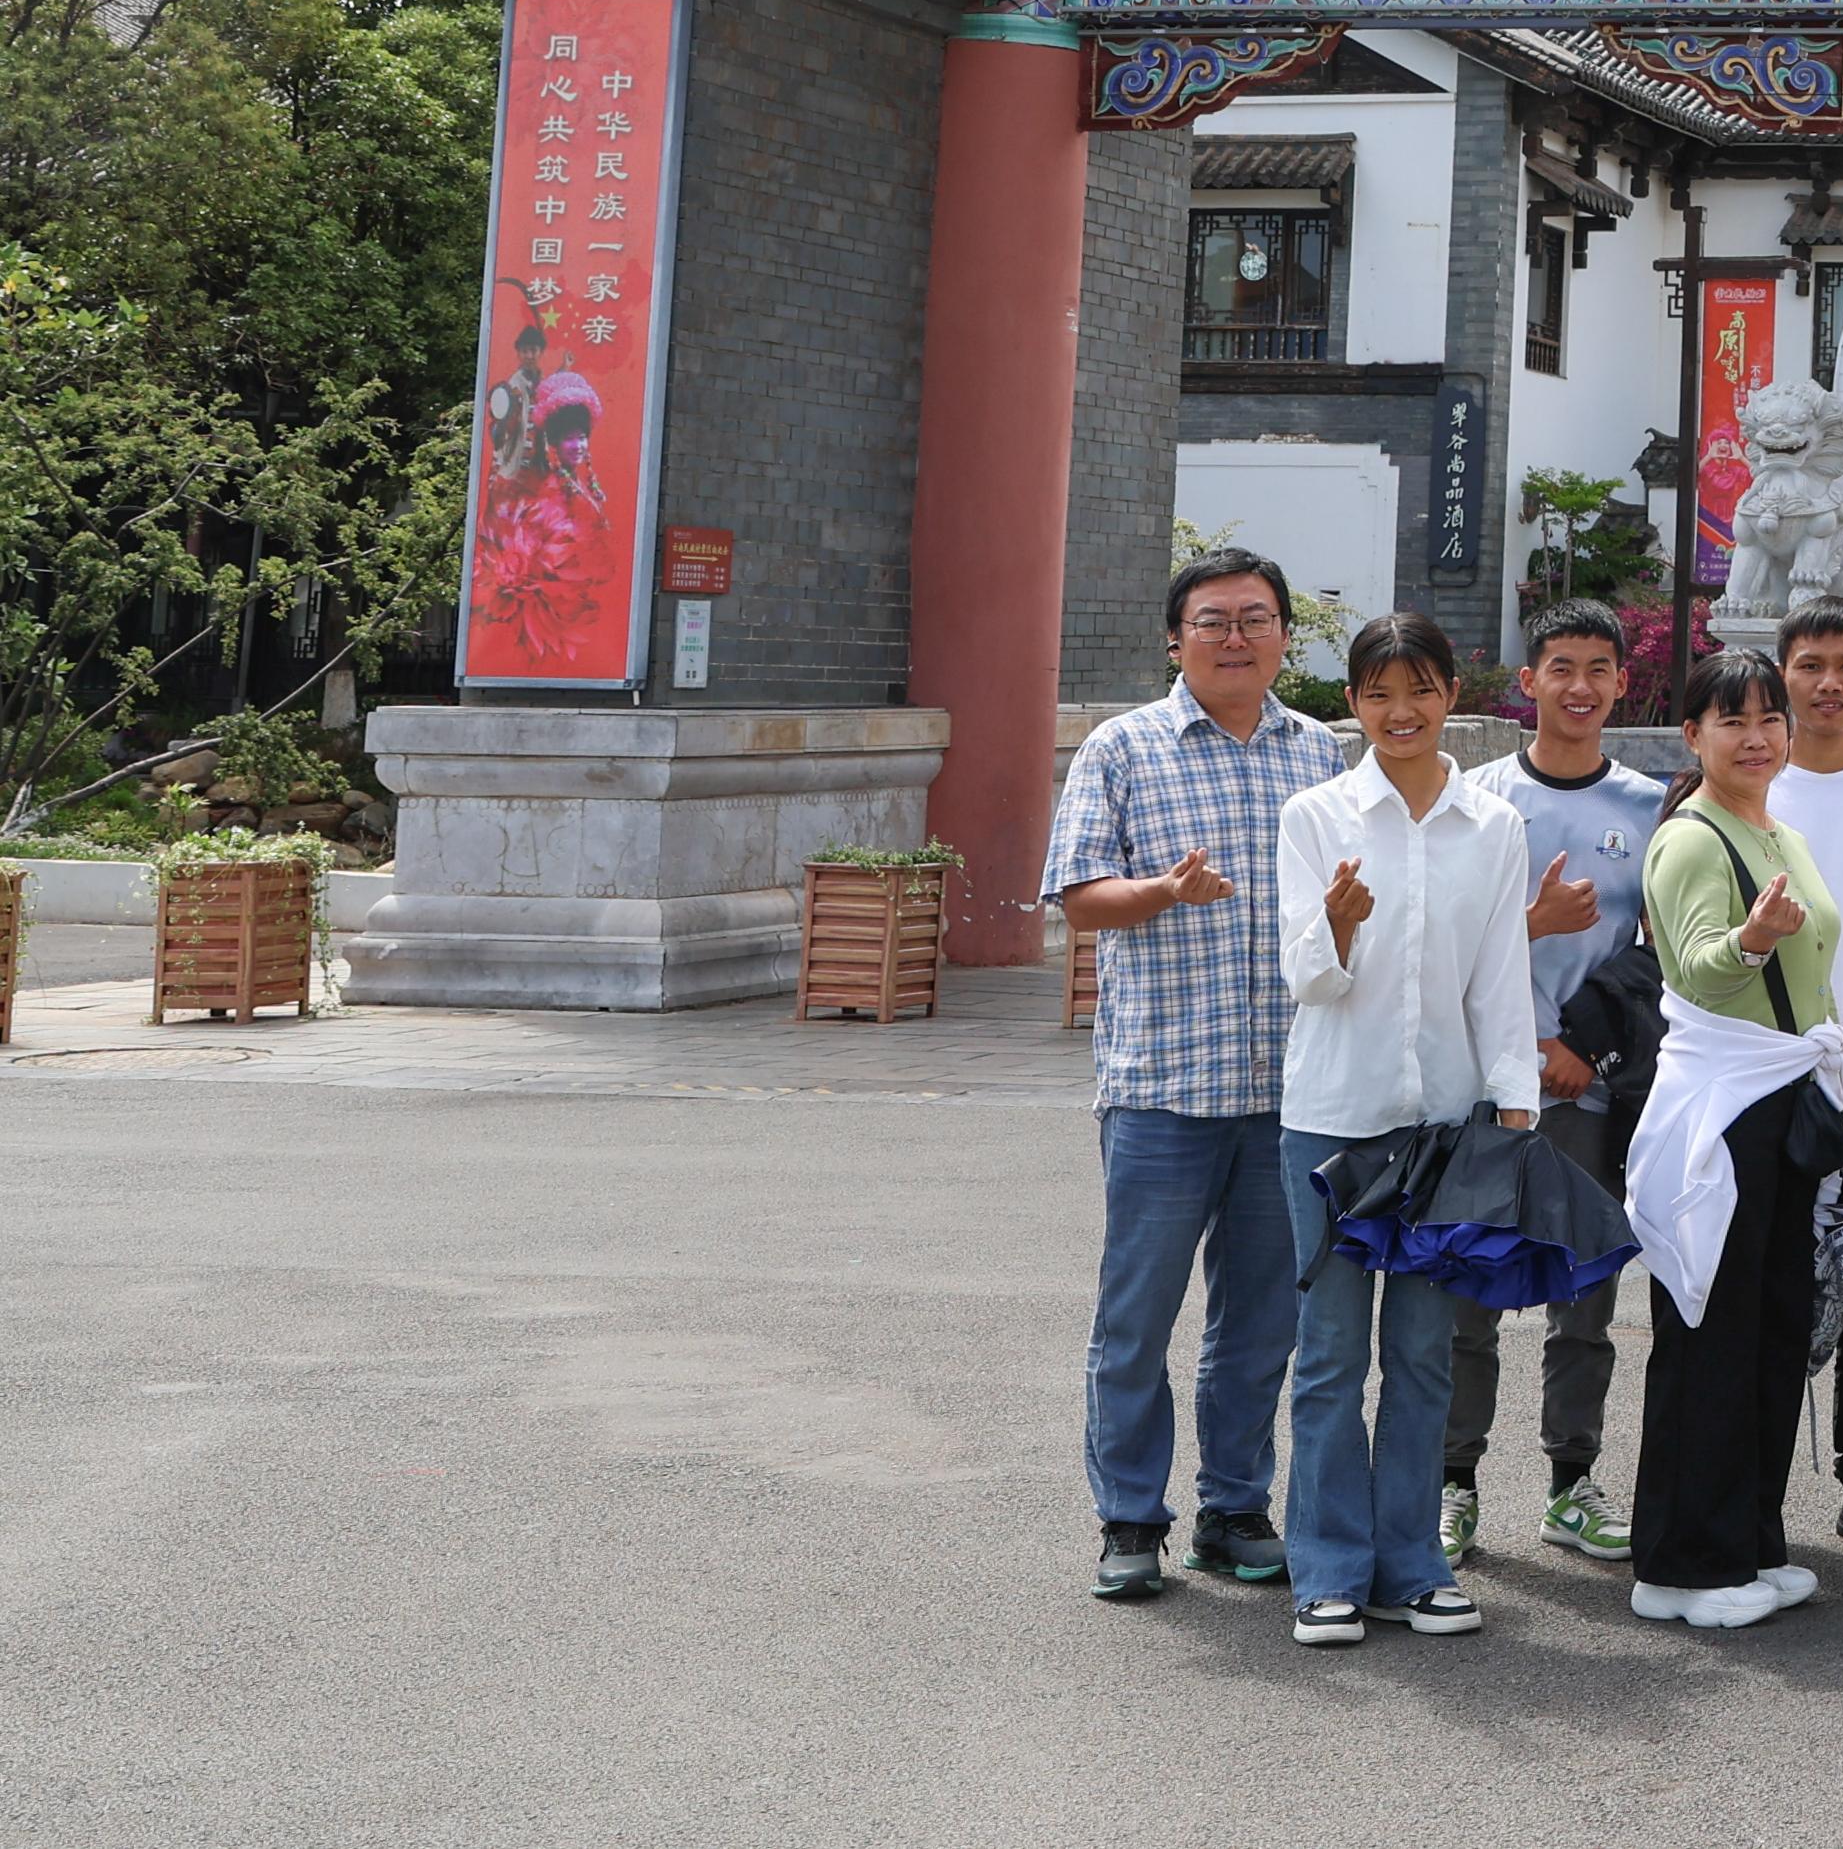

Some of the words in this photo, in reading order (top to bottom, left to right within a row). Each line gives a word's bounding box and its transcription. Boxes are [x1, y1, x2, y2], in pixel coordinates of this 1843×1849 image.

[527, 35, 579, 306] 同心共筑中国梦
[581, 70, 633, 344] 中华民族一家亲
